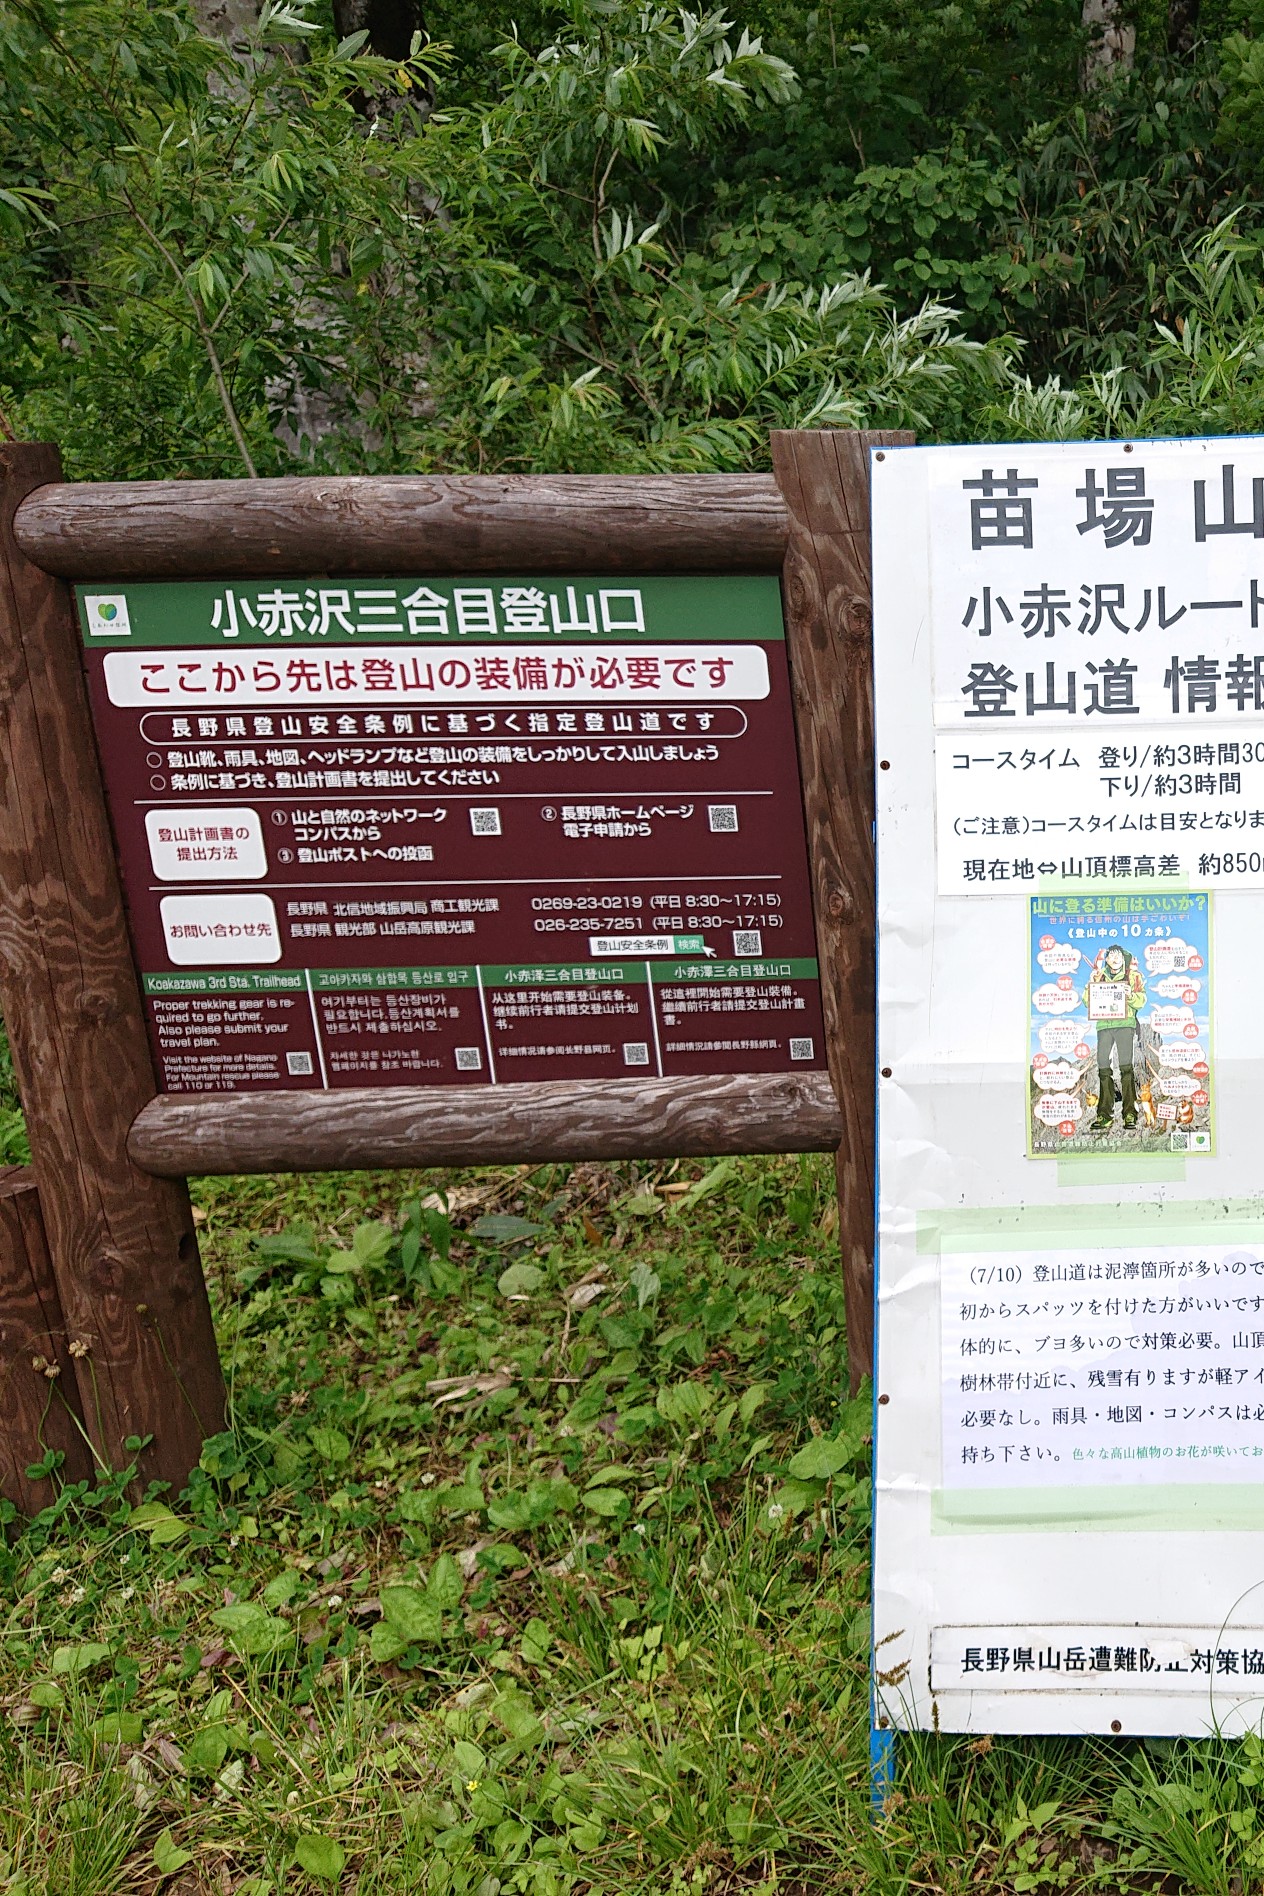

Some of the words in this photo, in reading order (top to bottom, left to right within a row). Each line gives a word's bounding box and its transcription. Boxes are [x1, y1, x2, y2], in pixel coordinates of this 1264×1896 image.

[962, 464, 1264, 550] 苗場山
[210, 586, 646, 638] 小赤沢三合目登山口
[140, 656, 735, 694] ここから先は登山の装備が必要です
[961, 656, 1140, 717] 登山道
[171, 711, 716, 738] 長野県登山安全条例に基づく指定登山道です
[166, 744, 719, 769] 登山靴、雨具、地図、ヘッドランプなど登山の装備をしっかりして入山しましょう
[953, 747, 1080, 770] コースタイム
[171, 768, 500, 791] 条例に基づき、登山計画書を提出してください
[1100, 772, 1241, 798] 下り/約3時間
[290, 807, 447, 827] 山と自然のネットワーク
[560, 804, 694, 821] 長野県ホームページ
[157, 826, 250, 843] 登山計画書の
[293, 826, 382, 842] コンパスから
[564, 822, 652, 838] 電子申請から
[176, 846, 238, 862] 提出方法
[297, 845, 434, 863] 登山ポストへの投函
[287, 901, 328, 917] 長野県
[333, 900, 428, 917] 北信地域振興局
[430, 898, 499, 914] 商工観光課
[531, 896, 643, 910] 0269-23-0219
[650, 896, 681, 911] (平日
[1033, 895, 1206, 914] 山に登る準備はいいか?
[169, 923, 272, 938] お問い合わせ先
[290, 923, 332, 938] 長野県
[335, 921, 376, 937] 観光部
[379, 919, 476, 937] 山岳高原観光課
[534, 917, 643, 932] 026-235-7251
[652, 916, 683, 931] (平日
[597, 939, 669, 952] 登山安全条例
[678, 939, 701, 951] 検索
[674, 964, 791, 979] 小赤澤三合目登山口
[147, 977, 206, 991] Koakazawa
[208, 976, 226, 989] 3rd
[252, 975, 301, 988] Trailhead
[153, 1000, 189, 1011] Proper
[192, 999, 237, 1011] trekking
[239, 999, 264, 1010] gear
[267, 999, 277, 1008] is
[279, 999, 295, 1008] re-
[155, 1013, 189, 1024] quired
[192, 1013, 204, 1022] to
[207, 1013, 221, 1024] go
[158, 1025, 183, 1036] Also
[185, 1025, 221, 1036] please
[224, 1023, 262, 1034] submit
[265, 1023, 289, 1034] your
[160, 1037, 191, 1047] travel
[194, 1037, 220, 1048] plan.
[163, 1055, 182, 1064] Visit
[184, 1055, 198, 1064] the
[233, 1054, 243, 1062] of
[210, 1063, 221, 1072] for
[223, 1063, 244, 1072] more
[166, 1073, 179, 1082] For
[961, 1444, 1061, 1464] 持ち下さい。
